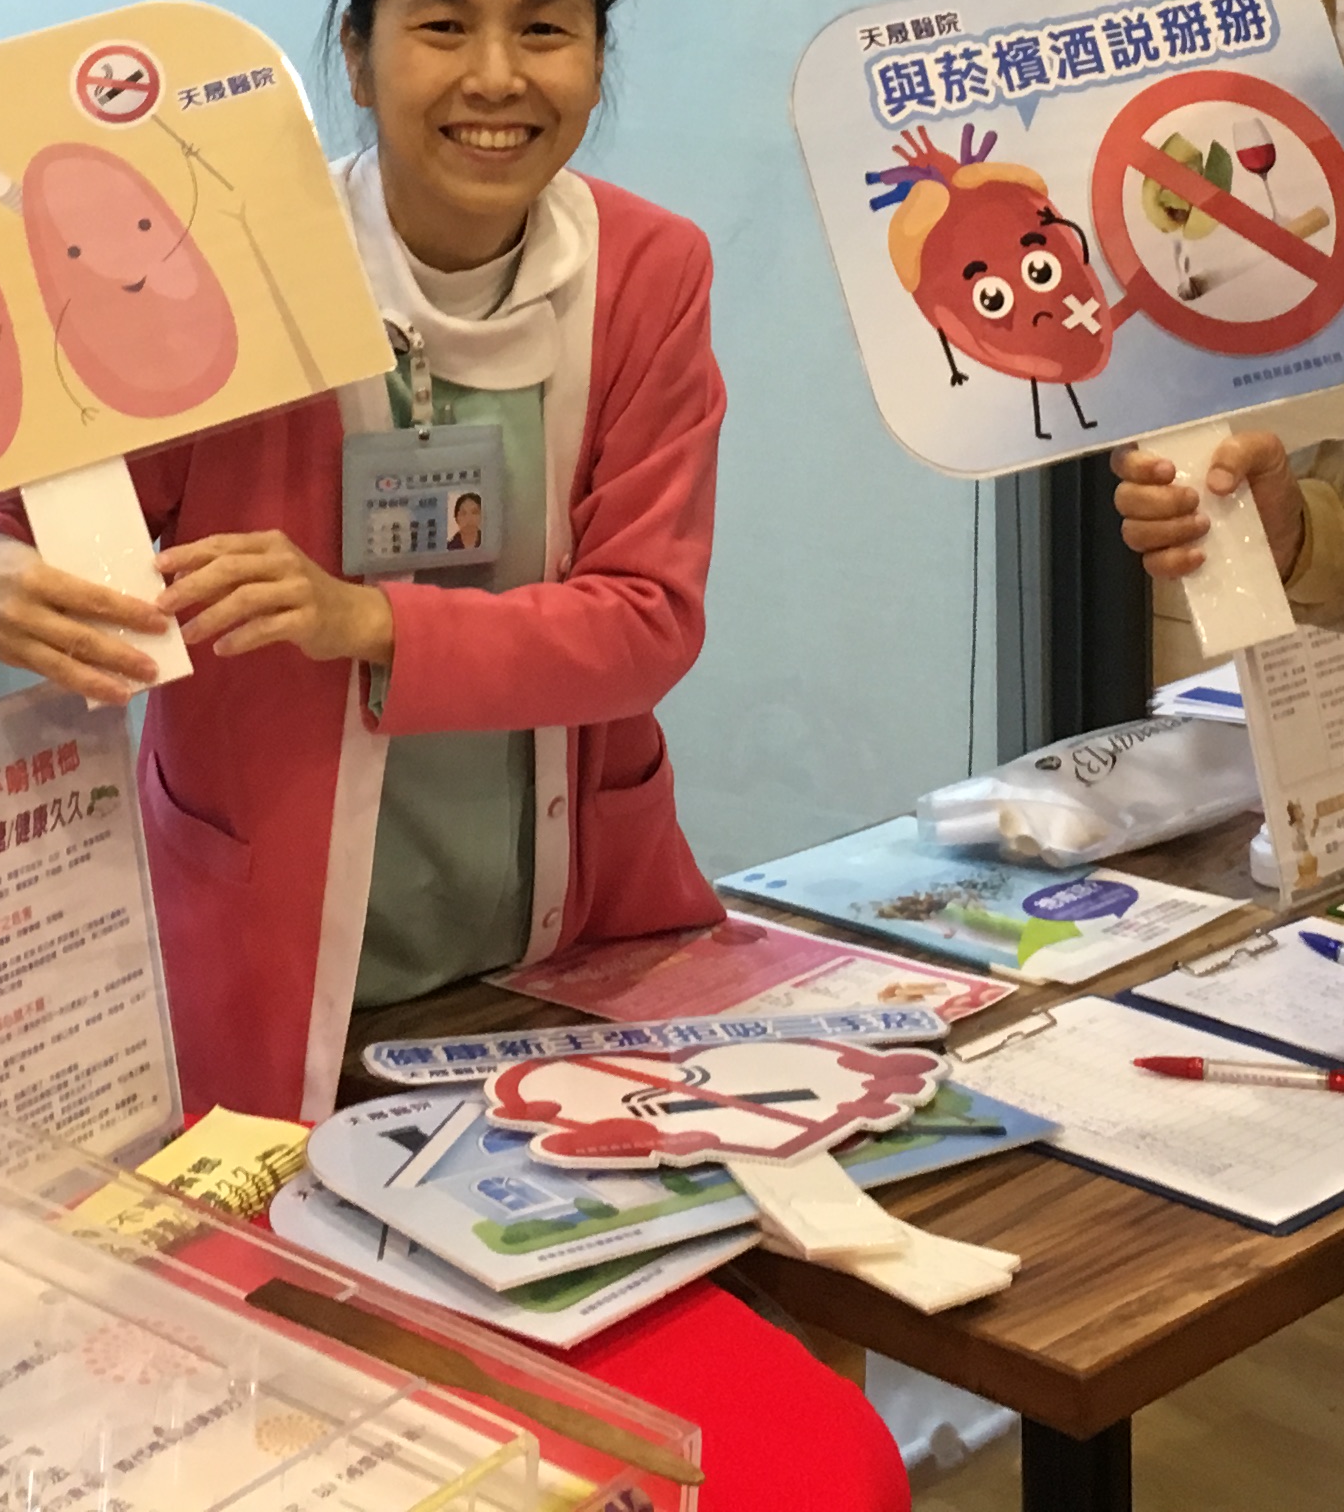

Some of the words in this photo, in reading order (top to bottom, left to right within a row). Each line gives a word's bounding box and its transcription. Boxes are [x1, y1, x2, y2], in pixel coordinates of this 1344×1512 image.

[859, 10, 963, 52] 天晟醫院
[177, 65, 278, 111] 天晟醫院
